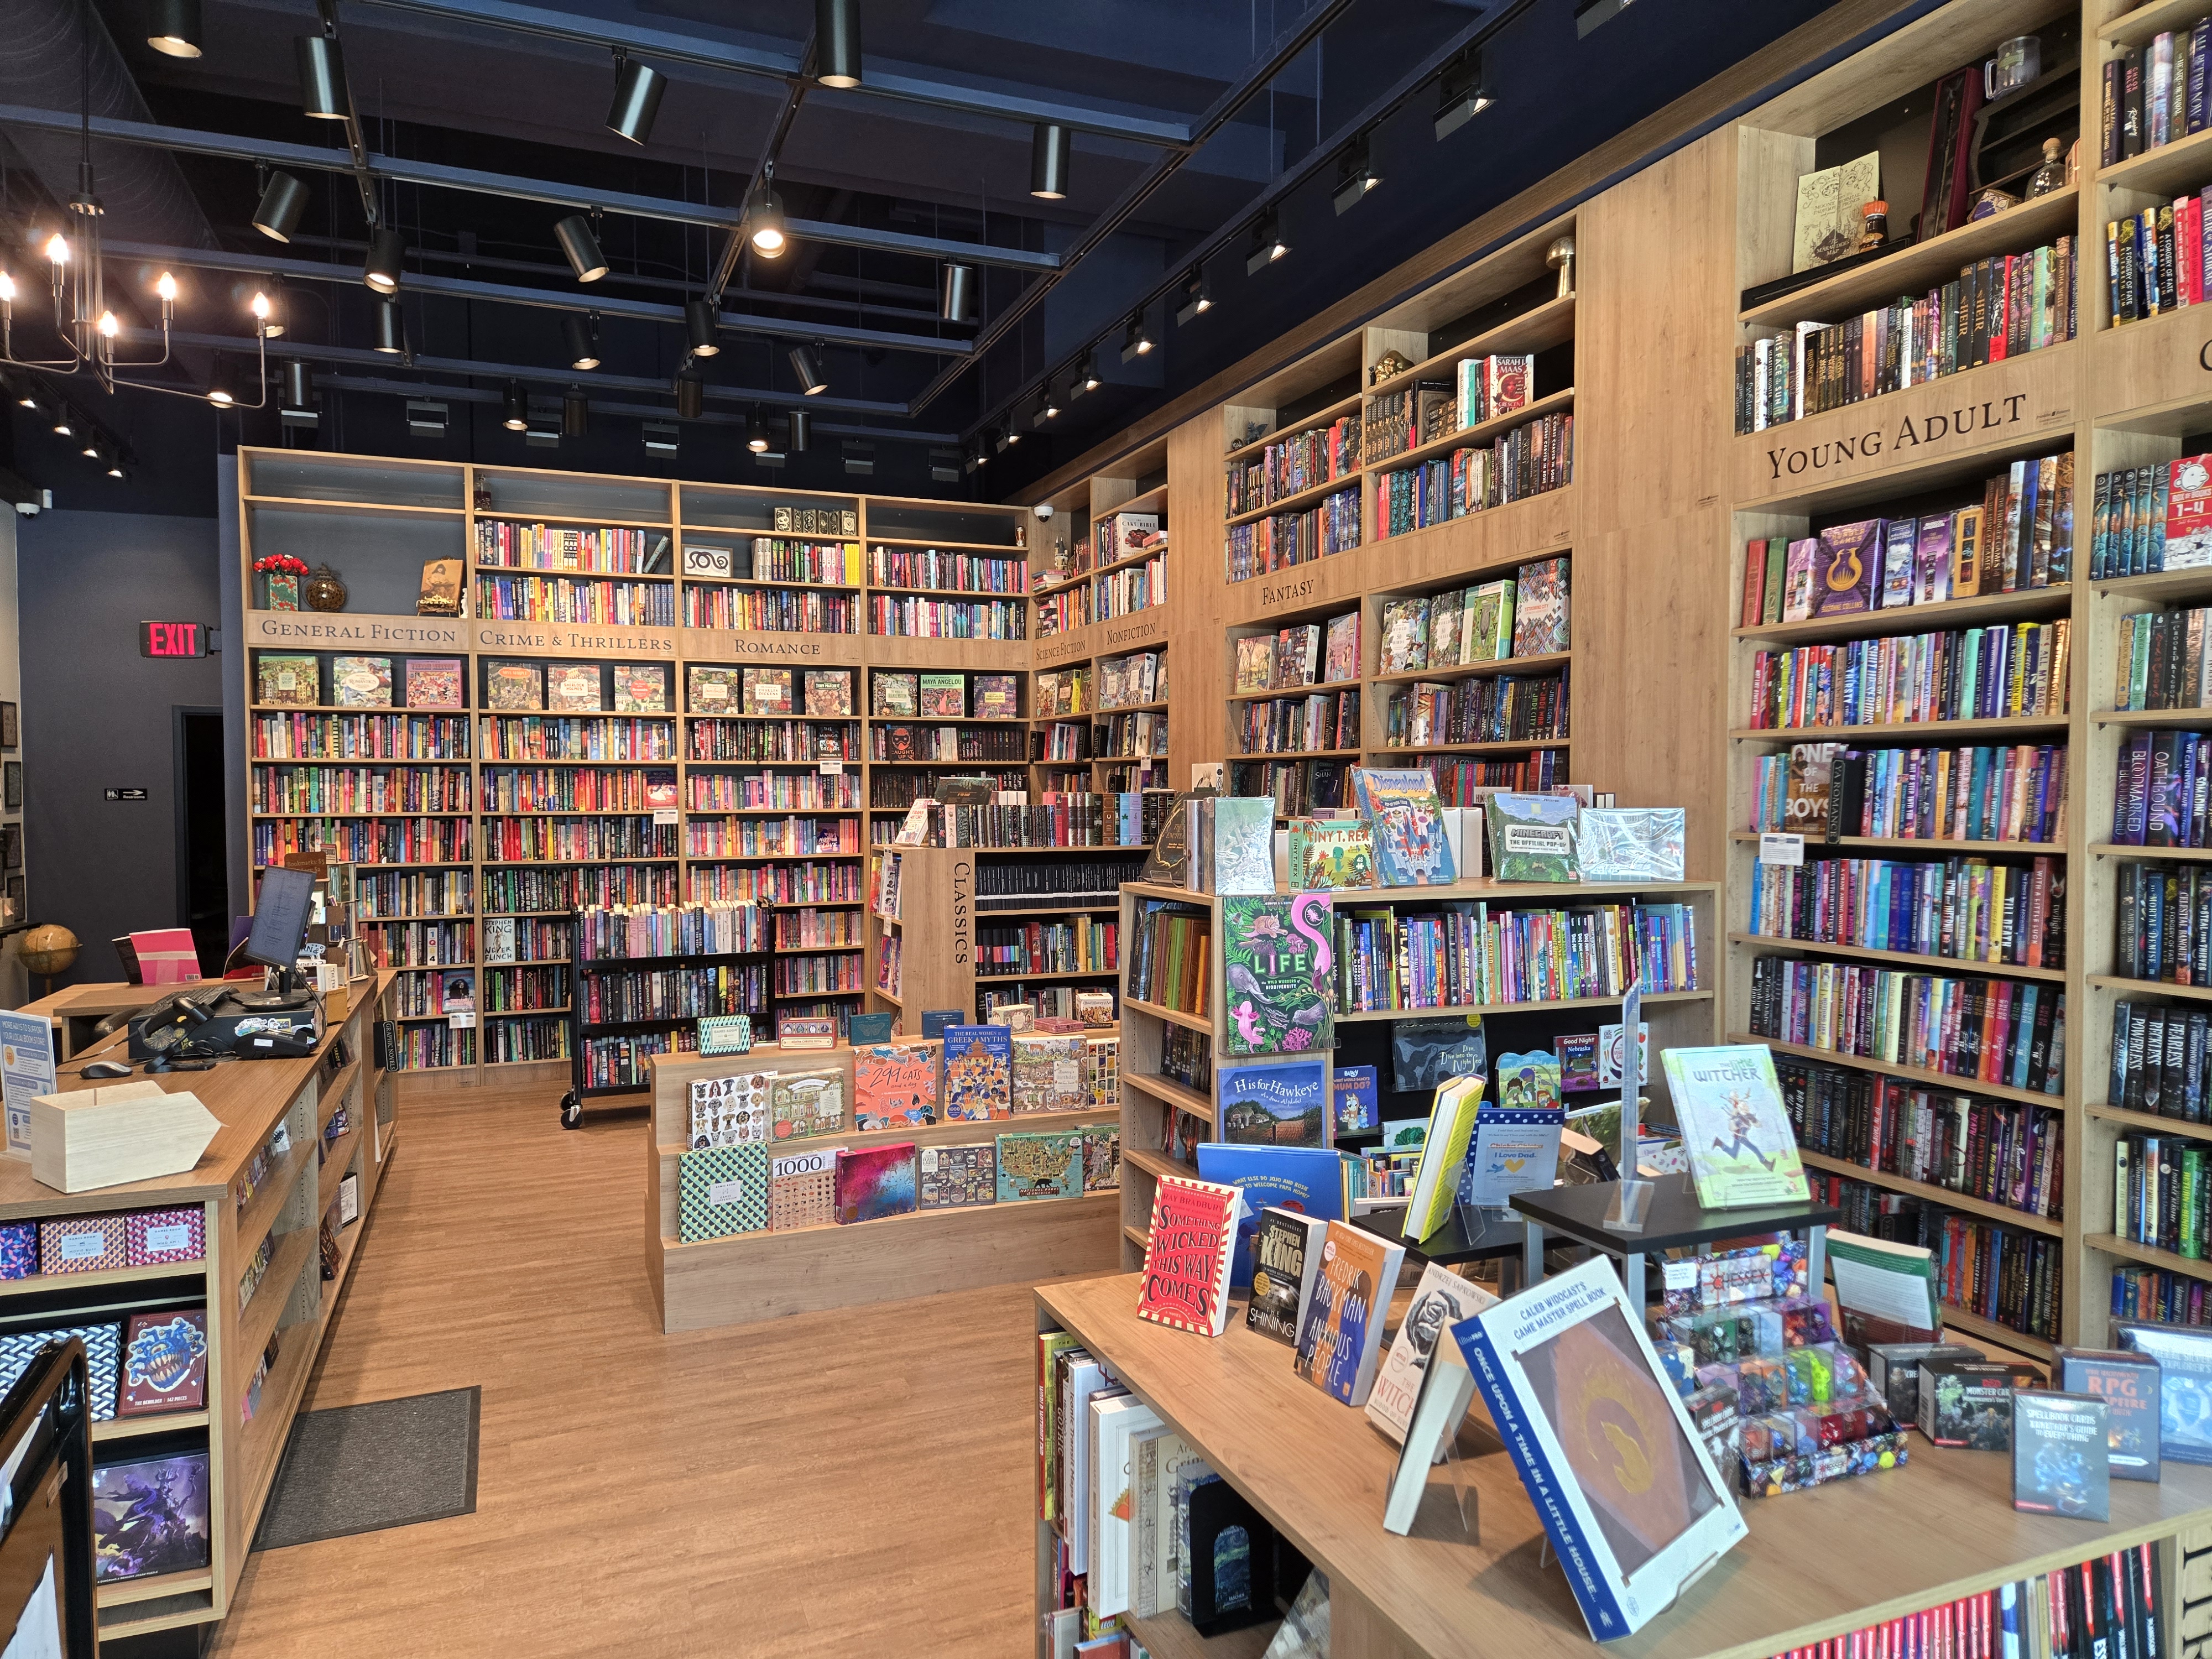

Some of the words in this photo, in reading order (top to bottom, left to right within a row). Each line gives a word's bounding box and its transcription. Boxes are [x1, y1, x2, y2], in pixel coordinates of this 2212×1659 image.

[1959, 304, 1969, 337] HEIR
[1974, 298, 1985, 331] HEIR
[1767, 431, 1881, 479] YOUNG
[1893, 393, 2026, 450] ADULT
[1262, 578, 1314, 605] FANTASY
[150, 623, 197, 655] EXIT
[262, 619, 365, 639] GENERAL
[371, 624, 456, 642] FICTION
[480, 630, 545, 646] CRIME
[552, 636, 562, 646] &
[567, 633, 672, 650] THRILLERS
[1107, 622, 1156, 645] NONFICTION
[735, 639, 821, 655] ROMANCE
[1036, 645, 1060, 661] SCIENCE
[1061, 640, 1086, 656] FICTION
[2039, 651, 2048, 665] ALL
[2038, 668, 2047, 683] MY
[2036, 685, 2047, 711] RAGE
[1792, 743, 1836, 763] ONE
[1315, 770, 1331, 779] SHAN
[1369, 772, 1427, 794] Disneyland
[1804, 767, 1817, 776] OF
[1834, 765, 1843, 780] YA
[1799, 783, 1819, 792] THE
[2127, 751, 2147, 832] BLOODMARKED
[2149, 752, 2169, 831] OATHBOUND
[2193, 776, 2206, 817] SOMADINA
[1785, 798, 1828, 817] BOYS
[1829, 782, 1841, 838] ROMANCE
[2116, 770, 2129, 835] BLOODMARKED
[1307, 831, 1334, 843] TINY
[1337, 830, 1346, 843] T.
[1348, 828, 1369, 842] REX
[1510, 828, 1564, 840] MINECRAFT
[954, 862, 971, 964] CLASSICS
[2003, 896, 2015, 917] TILL
[2001, 918, 2013, 948] DEATH
[1254, 953, 1306, 977] LIFE
[1399, 928, 1410, 988] FLAMER
[385, 1022, 393, 1047] GRAPHIC
[389, 1048, 398, 1071] NOVELS
[1463, 1045, 1475, 1053] Dive,
[1567, 1045, 1591, 1053] Nebraska
[2129, 1017, 2146, 1071] POWERLESS
[2146, 1021, 2163, 1066] RECKLESS
[2166, 1022, 2184, 1068] FEARLESS
[870, 1066, 901, 1088] 299
[903, 1068, 921, 1081] CATS
[1234, 1078, 1248, 1093] H
[1248, 1079, 1256, 1091] is
[1257, 1078, 1270, 1090] for
[1269, 1079, 1319, 1098] Hawkeye
[1333, 1083, 1353, 1091] MUM
[1353, 1081, 1371, 1089] DO?
[1692, 1067, 1762, 1083] WITCHER
[775, 1156, 823, 1177] 1000
[1233, 1176, 1246, 1185] WHAT
[1294, 1182, 1310, 1192] ROSIE
[1163, 1193, 1177, 1202] RAY
[1179, 1197, 1224, 1213] BRADBURY
[1158, 1205, 1221, 1232] SOMETHING
[1155, 1231, 1219, 1258] WICKED
[1269, 1225, 1301, 1248] STEPHEN
[1152, 1256, 1181, 1275] THIS
[1183, 1254, 1216, 1284] WAY
[1260, 1235, 1303, 1279] KING
[1330, 1255, 1363, 1290] FREDRIK
[1146, 1275, 1210, 1318] COMES
[1315, 1274, 1367, 1324] BACKMAN
[1427, 1267, 1452, 1287] ANDRZEJ
[1453, 1279, 1486, 1305] SAPKOWSKI
[1514, 1322, 1537, 1341] GAME
[1534, 1308, 1567, 1332] MASTER
[1564, 1297, 1588, 1316] SPELL
[1585, 1286, 1606, 1306] BOOK
[1519, 1300, 1545, 1321] CALEB
[1543, 1281, 1588, 1310] WIDOCAST'S
[1249, 1307, 1296, 1338] SHINING
[1308, 1316, 1353, 1361] ANXIOUS
[1305, 1344, 1343, 1387] PEOPLE
[2088, 1376, 2137, 1397] RPG
[2026, 1408, 2070, 1421] SPELLBOOK
[2072, 1413, 2096, 1426] CARDS
[1474, 1347, 1495, 1384] ONCE
[1491, 1383, 1512, 1421] UPON
[1509, 1422, 1519, 1433] A
[1515, 1432, 1535, 1467] TIME
[1530, 1466, 1543, 1484] IN
[1539, 1483, 1548, 1497] A
[1545, 1497, 1574, 1545] LITTLE
[1100, 1618, 1116, 1630] LEGO
